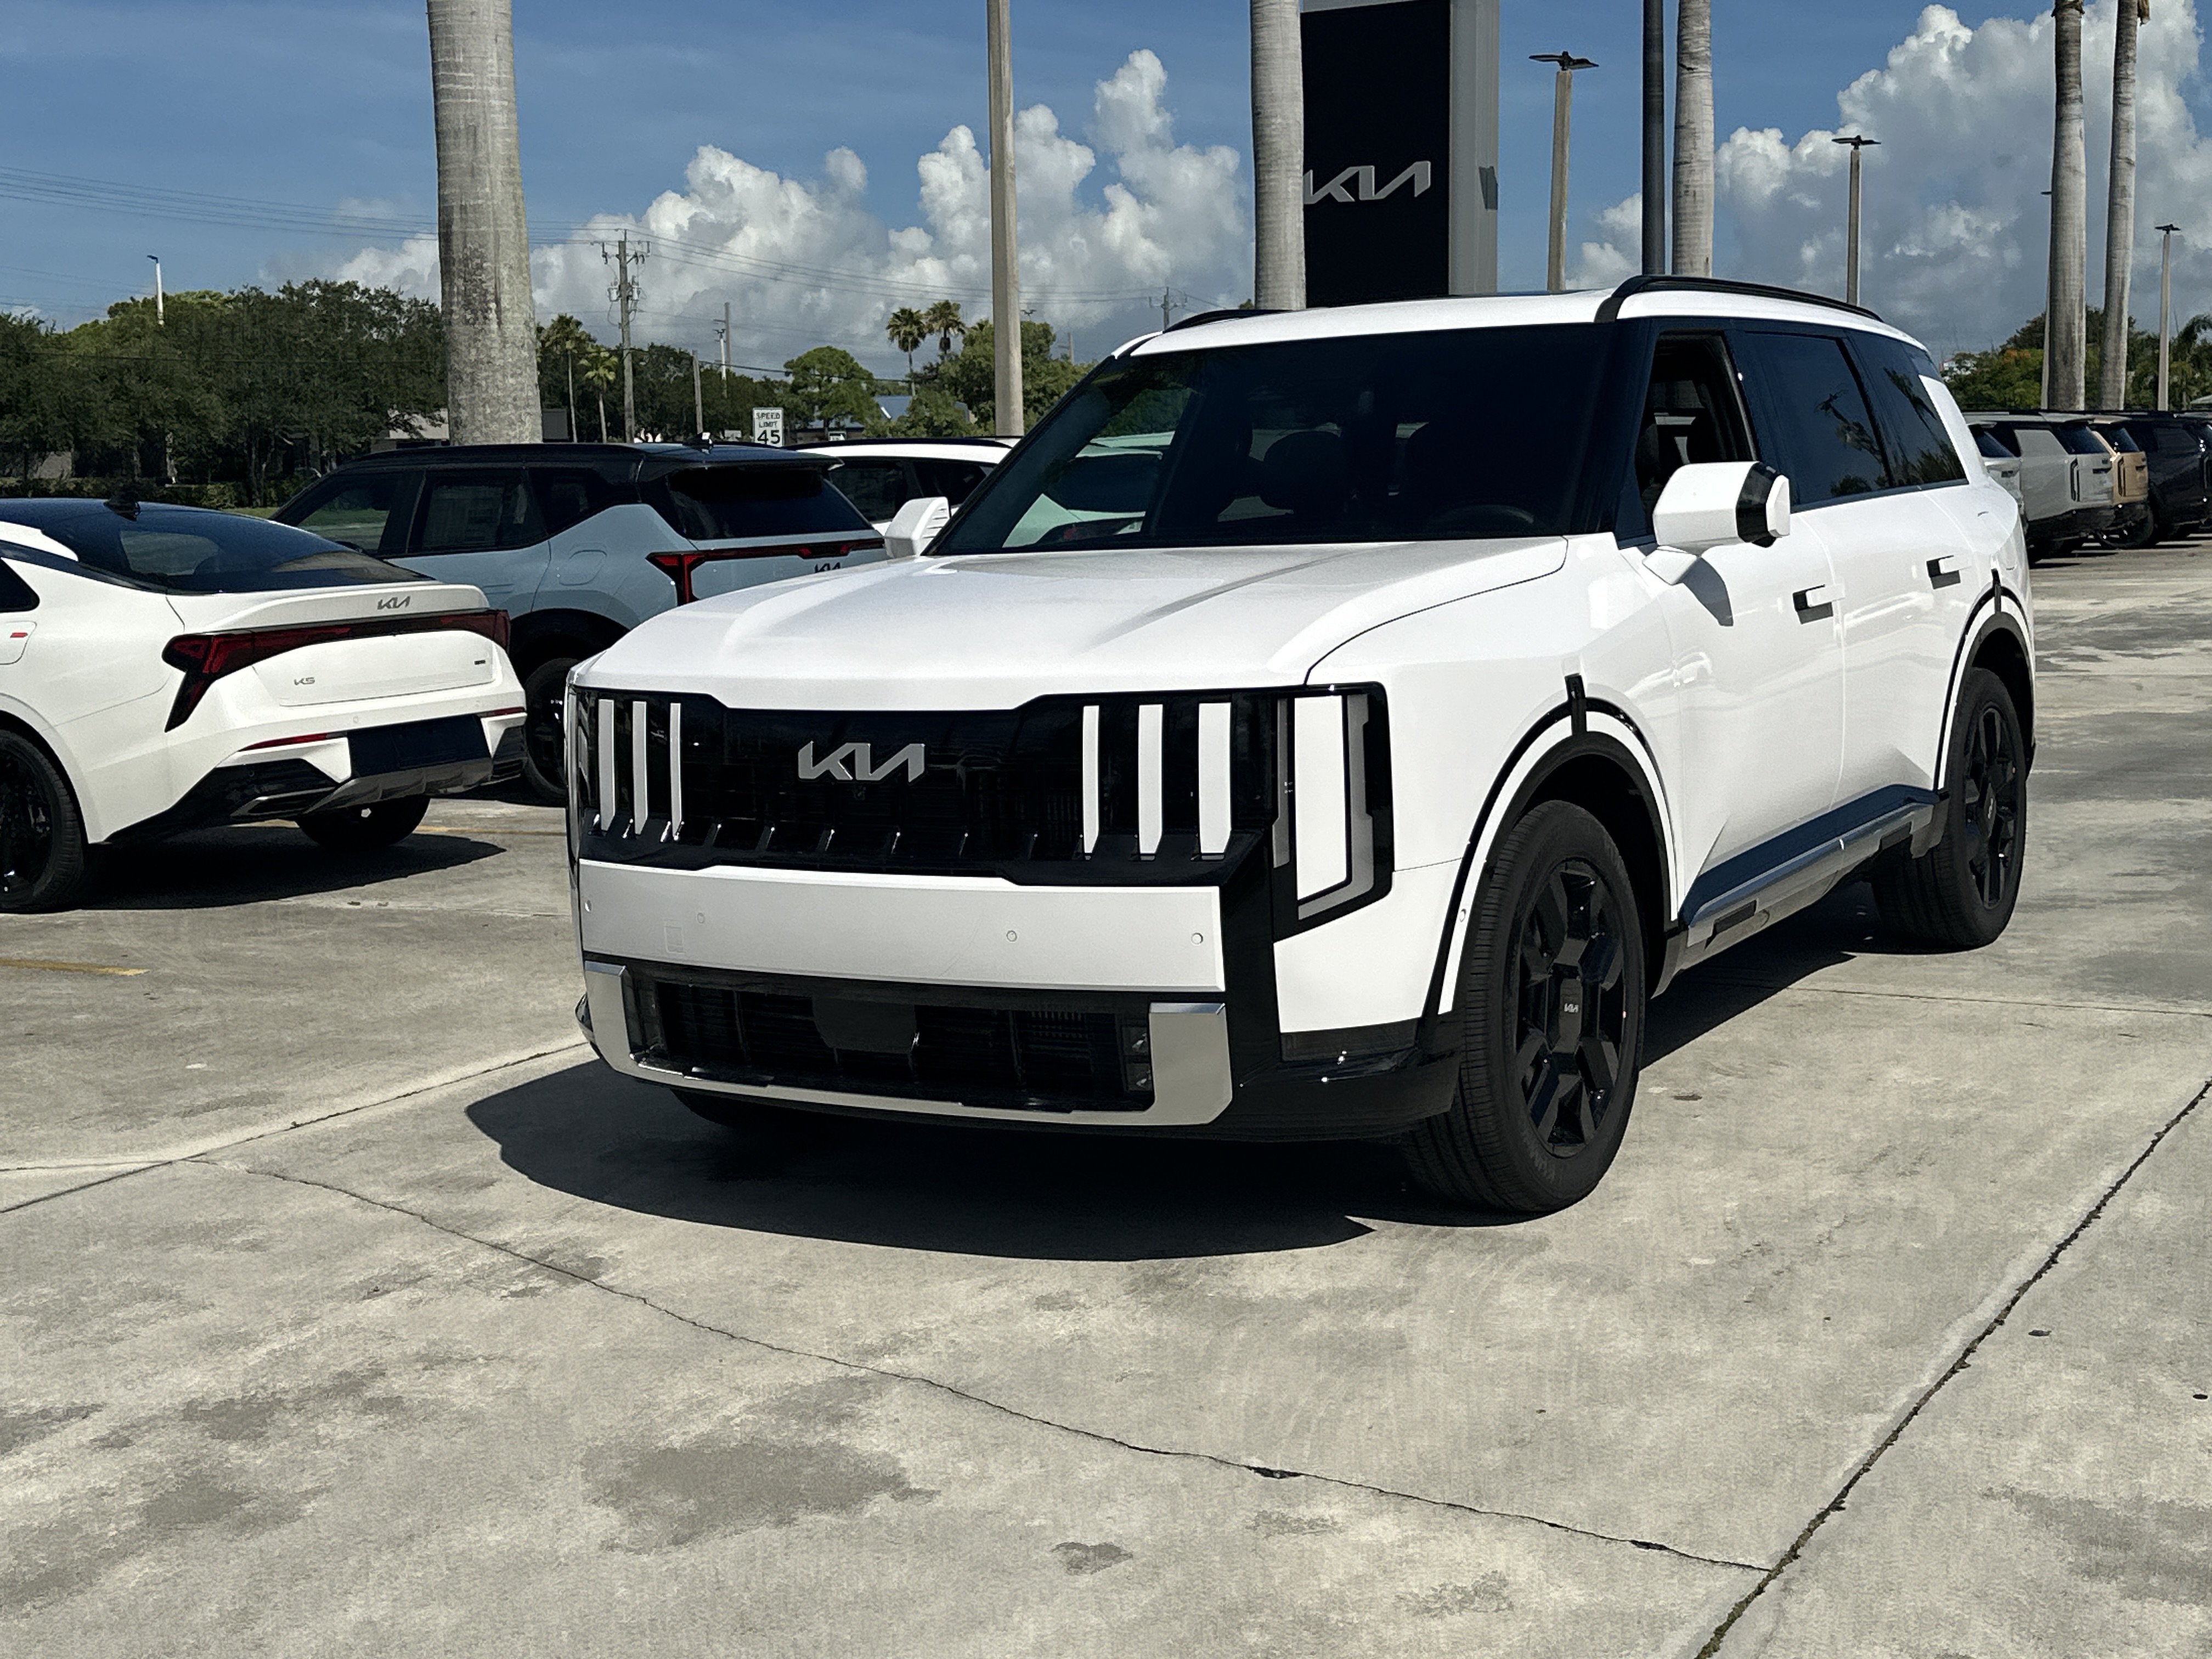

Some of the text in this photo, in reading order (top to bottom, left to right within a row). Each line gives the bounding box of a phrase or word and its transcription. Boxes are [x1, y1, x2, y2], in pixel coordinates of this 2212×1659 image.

[1303, 160, 1431, 205] KIA
[757, 430, 781, 445] 45
[377, 596, 410, 610] KIA
[798, 741, 925, 782] KIA
[1564, 1003, 1579, 1013] KIA
